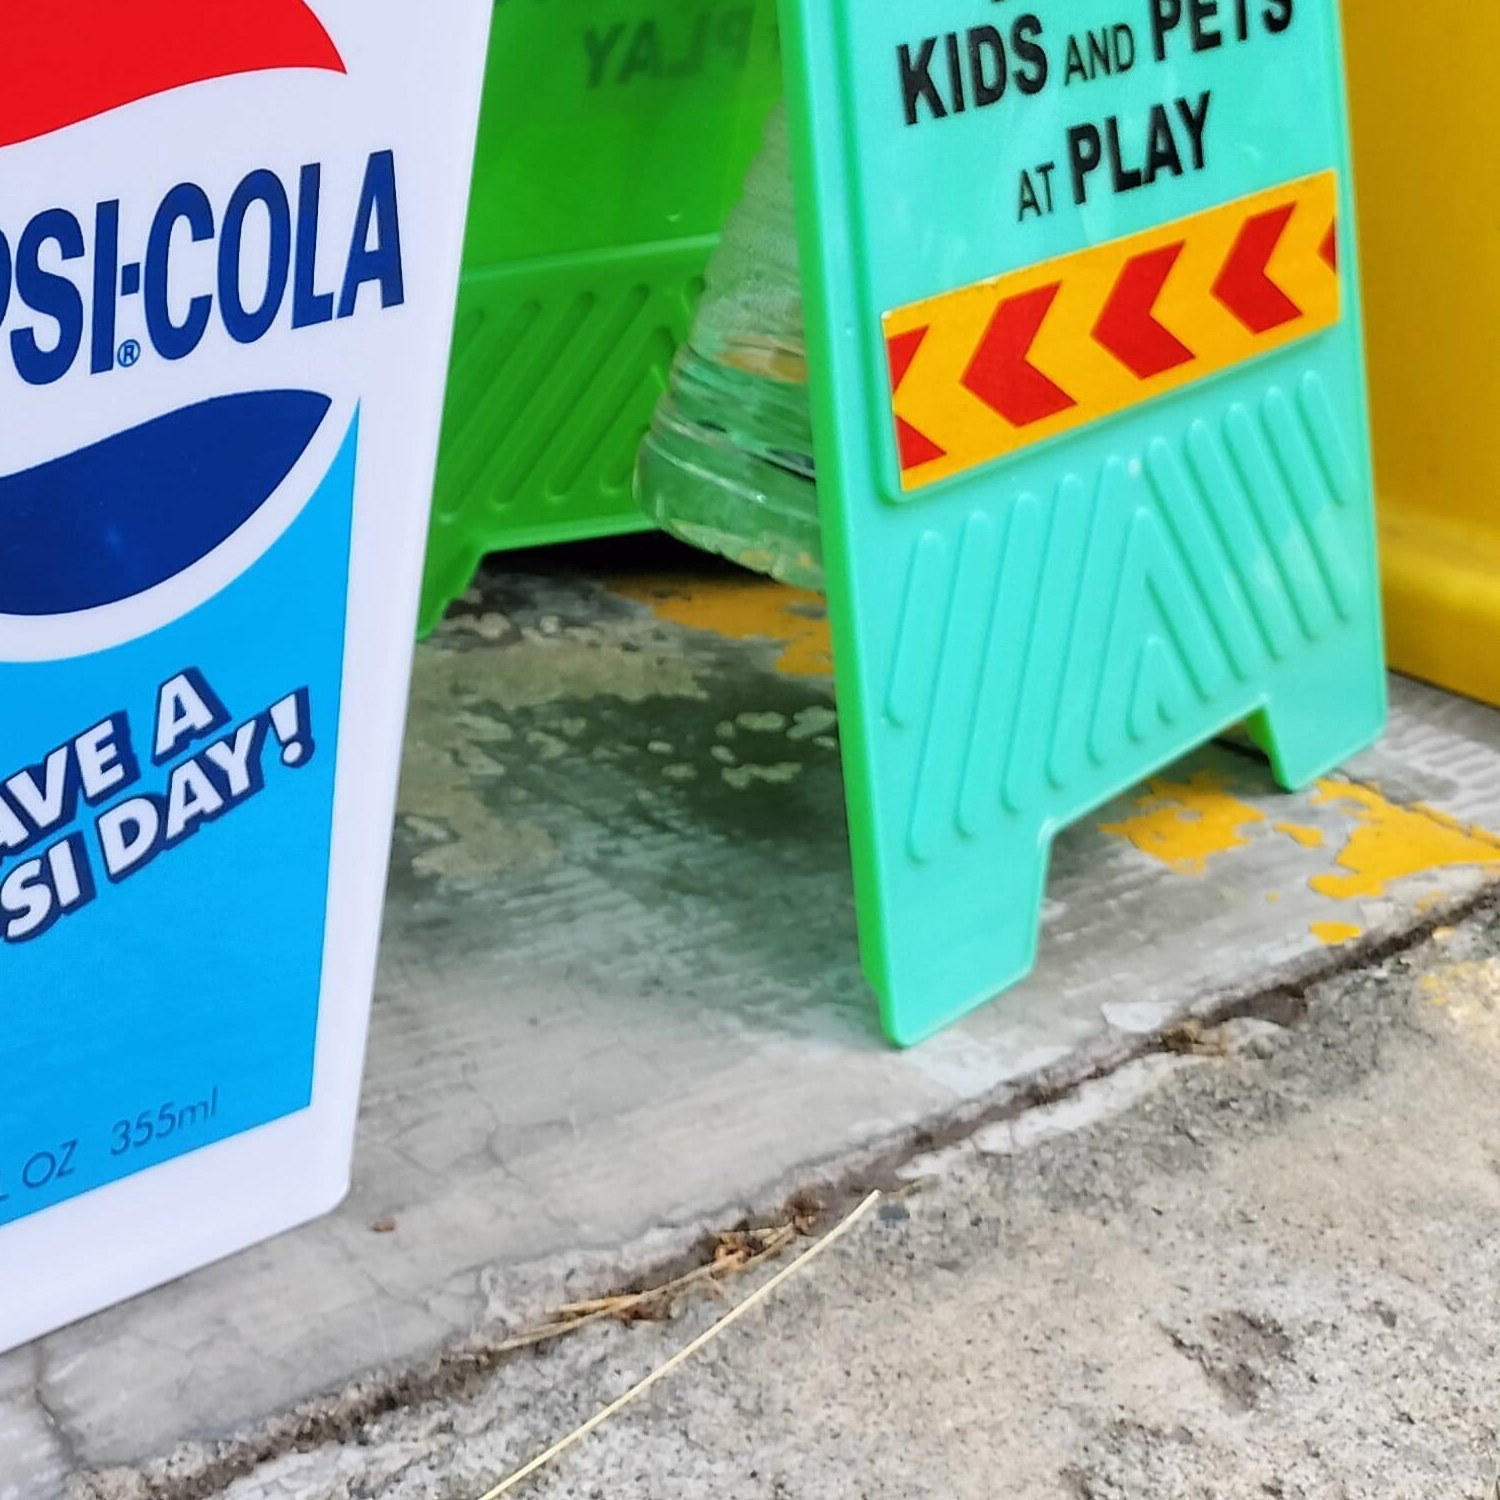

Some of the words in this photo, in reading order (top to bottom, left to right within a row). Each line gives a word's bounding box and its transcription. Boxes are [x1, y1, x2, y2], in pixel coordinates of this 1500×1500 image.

[897, 13, 1047, 126] KIDS
[1065, 23, 1136, 87] AND
[1018, 160, 1055, 221] AT
[1067, 91, 1211, 205] PLAY
[152, 666, 232, 767] A
[21, 1139, 79, 1189] OZ
[110, 1085, 219, 1157] 355ml
